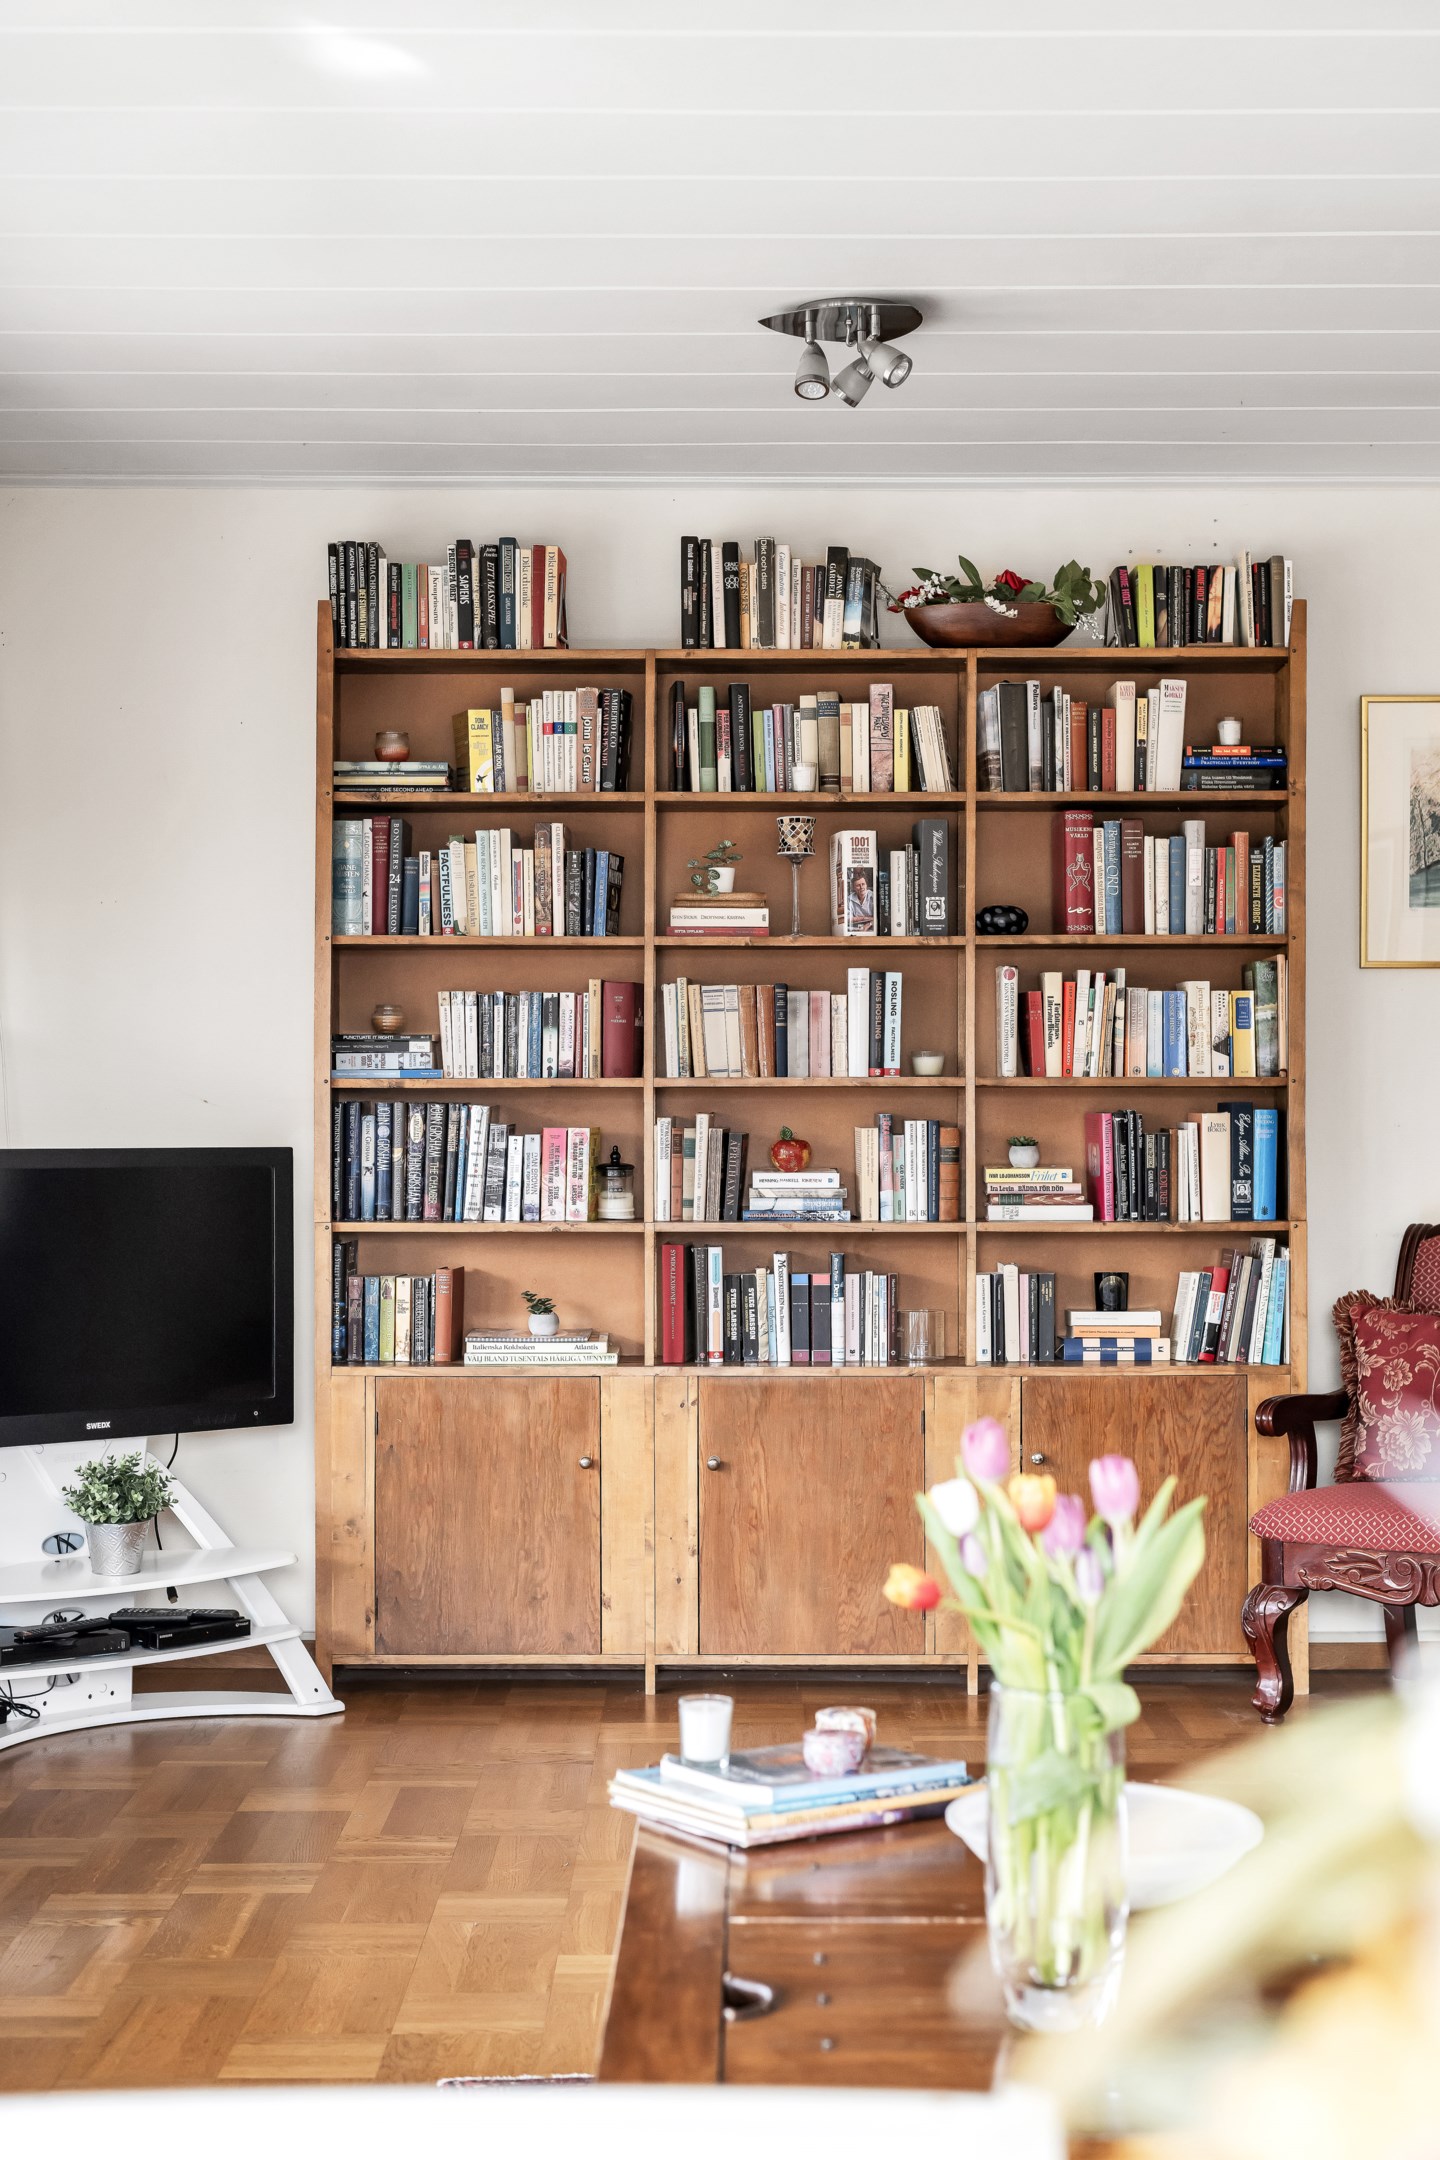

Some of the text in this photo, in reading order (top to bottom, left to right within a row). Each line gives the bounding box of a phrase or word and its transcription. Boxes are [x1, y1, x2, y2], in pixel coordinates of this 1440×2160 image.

[449, 548, 457, 574] PRECIS
[547, 551, 555, 568] Dikt
[760, 539, 768, 555] Dikt
[369, 546, 377, 606] AGATHA CHRISTIE
[522, 556, 530, 573] Dikt
[828, 562, 836, 598] GARDELL
[1119, 569, 1128, 588] ANNE
[459, 574, 470, 605] SAPIENS
[487, 562, 496, 626] ETT MASKSPEL
[853, 567, 863, 607] Scandinavians
[1121, 589, 1131, 606] HOLT
[1197, 569, 1205, 602] ANNE HOLT
[741, 595, 749, 616] MUSIK
[610, 692, 619, 730] UMBERTO
[496, 744, 502, 754] ÅR
[581, 716, 593, 783] John le Carré
[850, 836, 870, 847] 1001
[929, 829, 943, 893] William Shakespeare
[389, 873, 401, 884] 24
[440, 852, 452, 926] FACTFULNESS
[1106, 865, 1119, 896] ORD
[1252, 864, 1260, 924] ELIZABETH GEORGE
[874, 979, 882, 1040] HANS ROSLING
[890, 980, 898, 1017] ROSLING
[1196, 986, 1206, 1022] Jerusalem
[376, 1106, 391, 1171] JOHN GRISHAM
[1104, 1118, 1112, 1145] William
[1234, 1113, 1251, 1177] Edgar Allan Poe
[428, 1104, 444, 1205] JOHN GRISHAM THE CHAMBER
[1104, 1146, 1112, 1165] Trevor
[407, 1151, 422, 1204] JOHN GRISHAM
[726, 1139, 738, 1206] APRILHÄXAN
[1031, 1170, 1058, 1181] Frihet
[1051, 1184, 1064, 1192] DÖD
[1159, 1169, 1168, 1207] ODJURET
[777, 1259, 786, 1306] MOSKITKUSTEN
[1226, 1290, 1234, 1310] Barbarian
[748, 1309, 756, 1340] LARSSON
[467, 1354, 483, 1362] VÄLJ
[549, 1354, 581, 1362] HÄRLIGA
[86, 1421, 111, 1430] SWEDX
